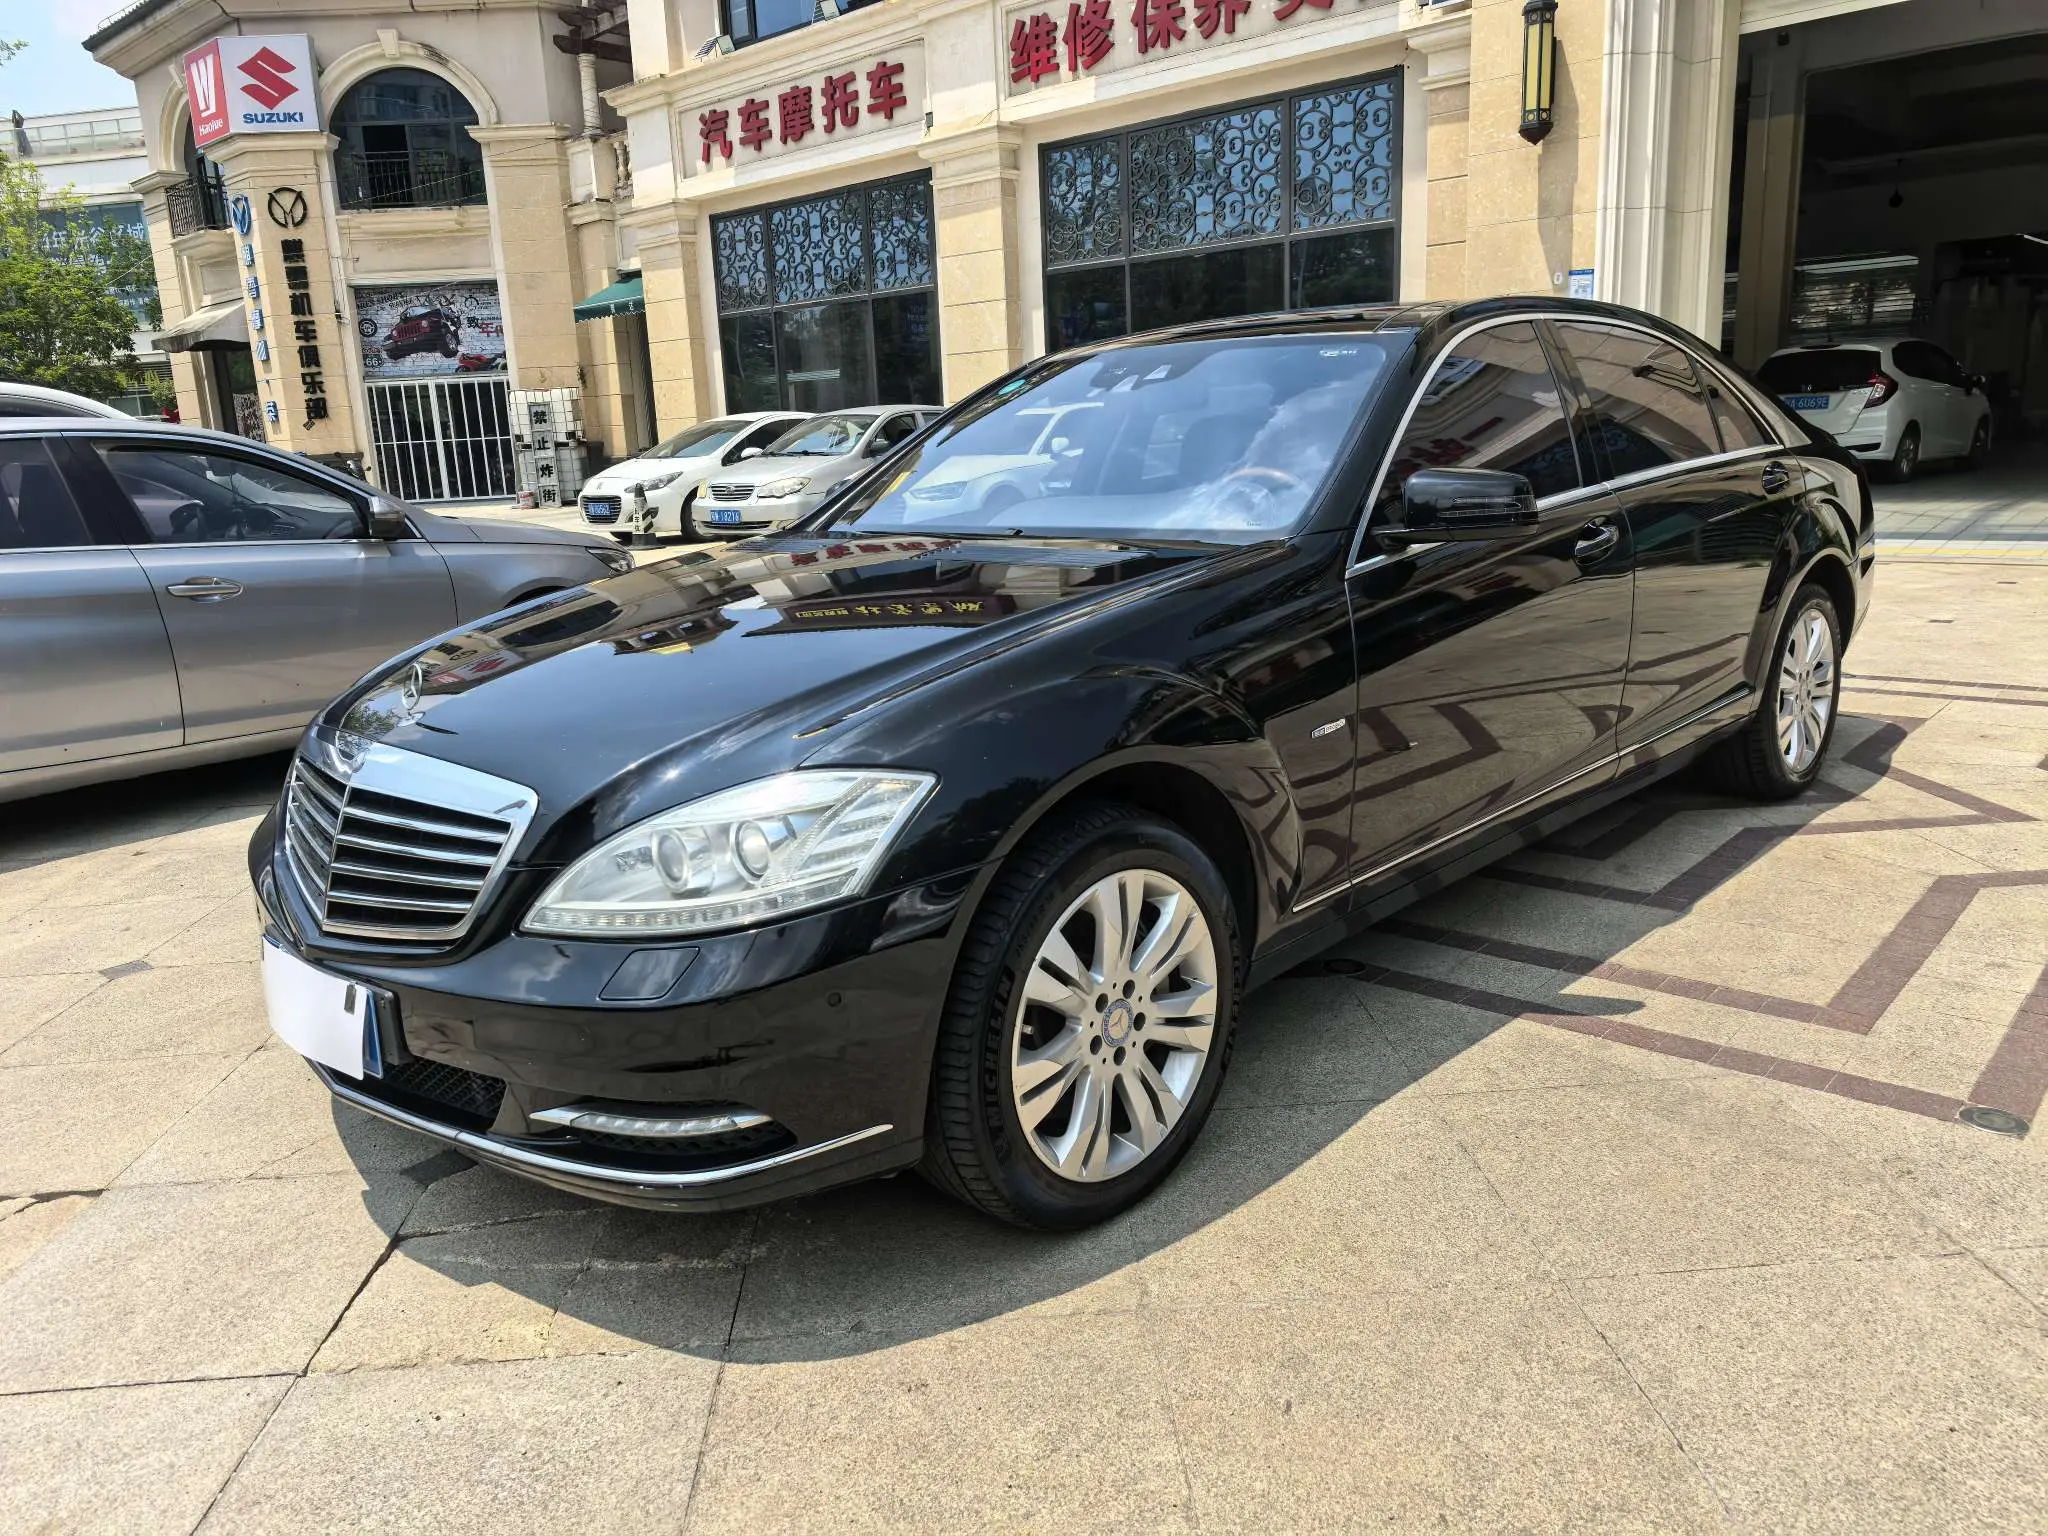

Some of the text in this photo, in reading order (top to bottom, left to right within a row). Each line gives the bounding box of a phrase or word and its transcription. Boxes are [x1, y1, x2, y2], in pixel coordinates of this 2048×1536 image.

[242, 111, 304, 124] SUZUKI
[699, 61, 907, 163] 汽车摩托车
[532, 410, 556, 502] 禁止炸街
[984, 977, 1013, 1127] MICHELIN
